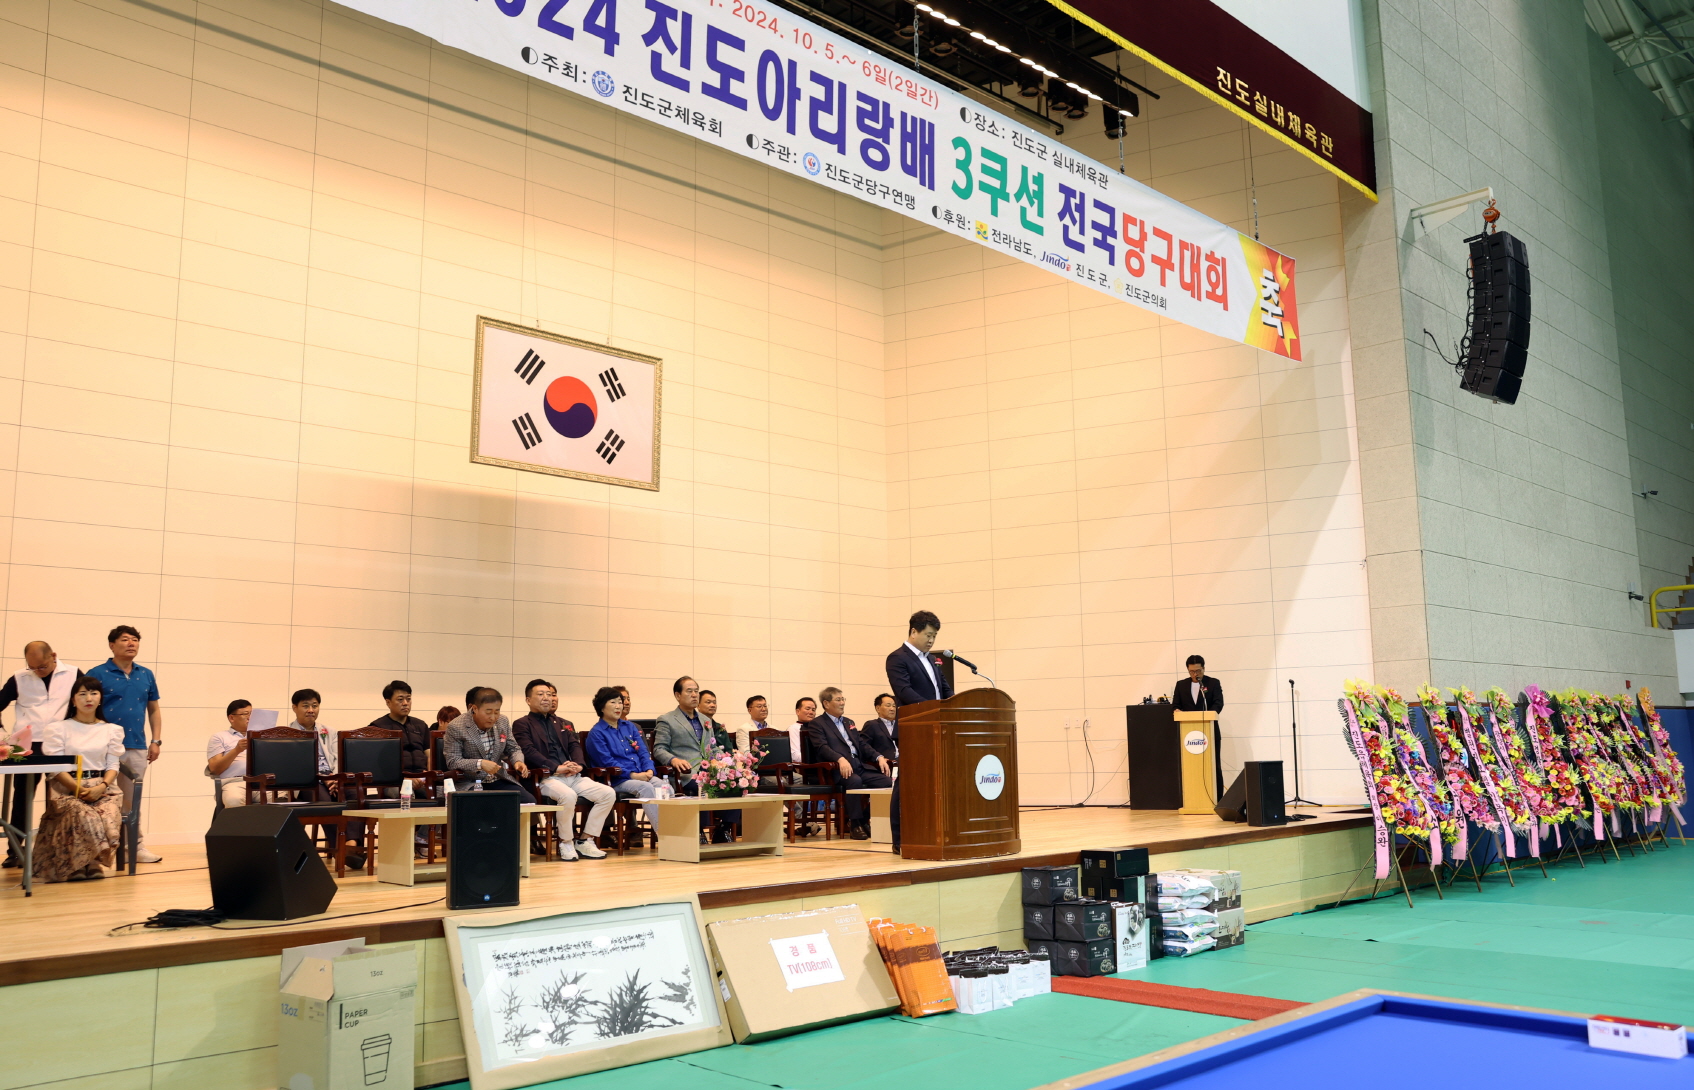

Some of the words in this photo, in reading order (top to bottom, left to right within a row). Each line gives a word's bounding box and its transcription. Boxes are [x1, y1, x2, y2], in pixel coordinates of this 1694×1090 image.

[541, 53, 587, 84] 주최:
[622, 84, 723, 138] 진도군체육회
[732, 1, 784, 38] 2024.
[793, 28, 818, 54] 10.
[862, 60, 939, 110] 6일(2일간)
[641, 0, 935, 192] 진도아리랑배
[951, 136, 1044, 236] 3쿠션
[974, 112, 1005, 139] 장소:
[1012, 130, 1048, 161] 진도군
[1052, 150, 1109, 190] 실내체육관
[1216, 66, 1334, 158] 진도실내체육관
[762, 138, 798, 164] 주관:
[825, 163, 916, 210] 진도군당구연맹
[943, 208, 971, 231] 후원:
[991, 228, 1037, 259] 전라남도,
[1125, 283, 1167, 311] 진도군의회
[1260, 268, 1285, 339] 축
[344, 1009, 369, 1019] PAPER
[344, 1020, 360, 1029] CUP
